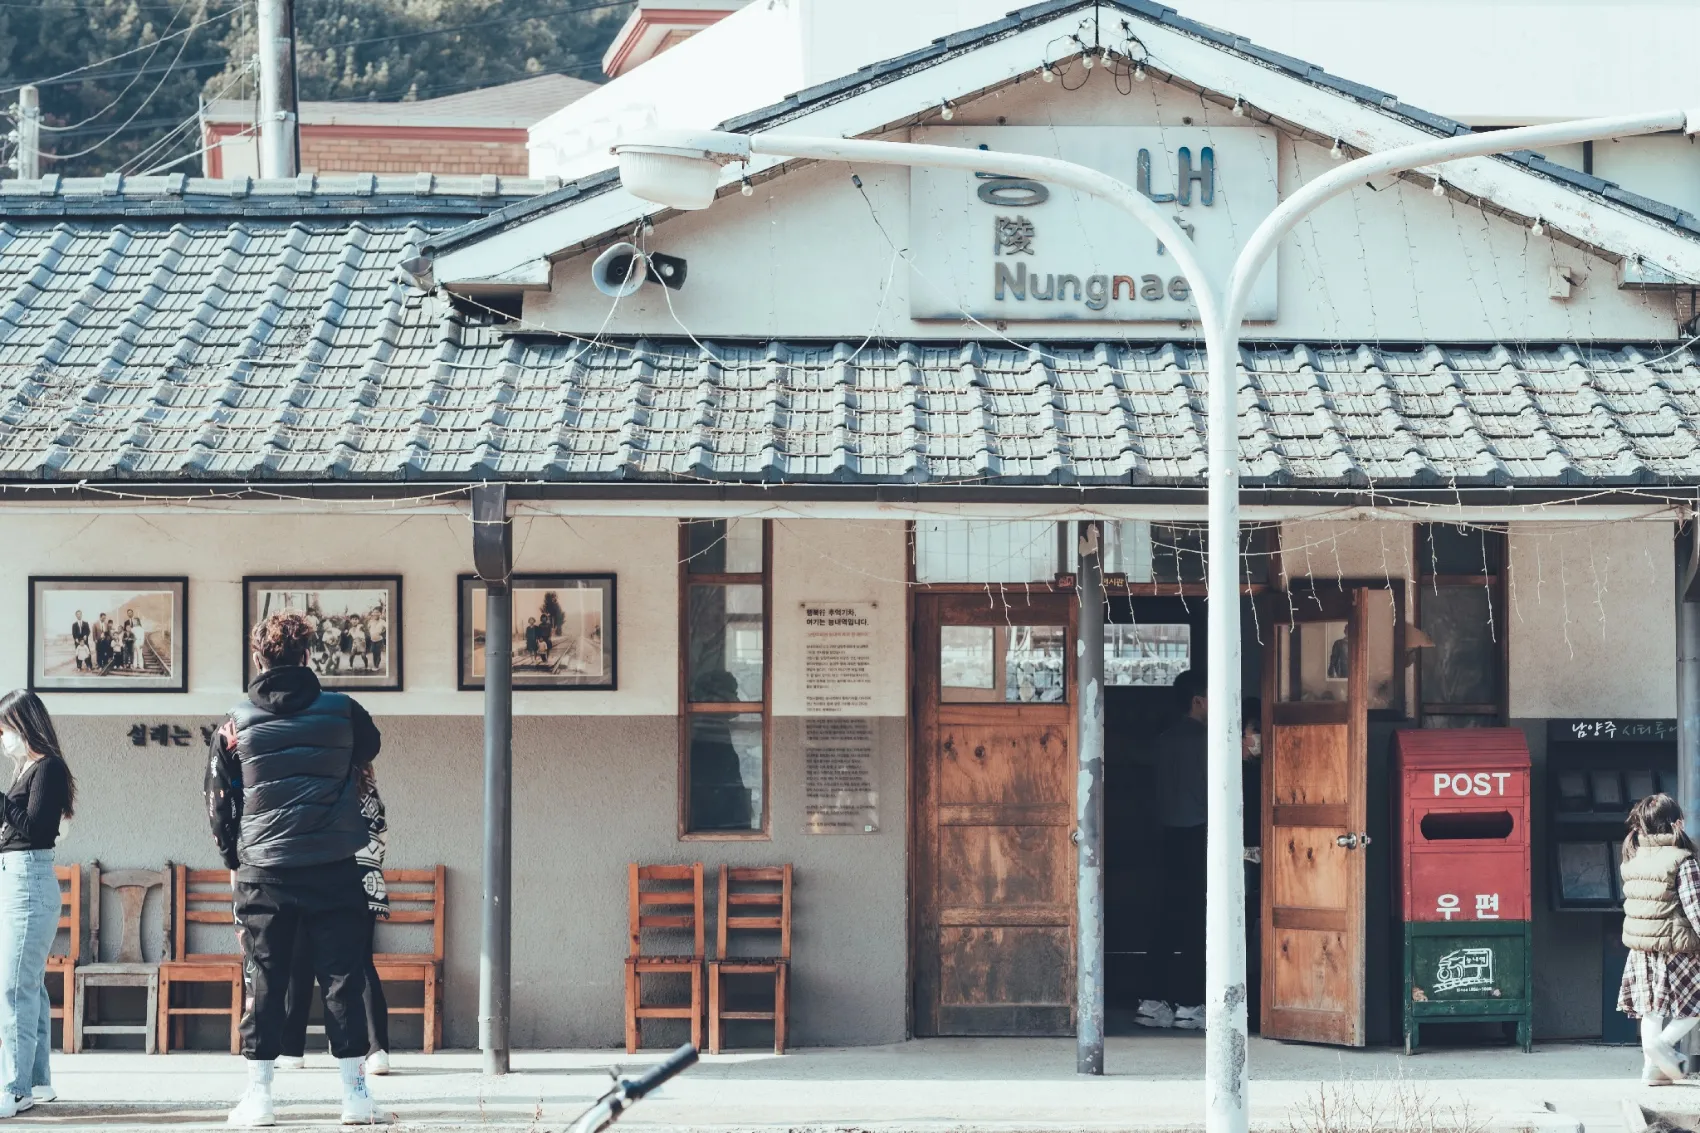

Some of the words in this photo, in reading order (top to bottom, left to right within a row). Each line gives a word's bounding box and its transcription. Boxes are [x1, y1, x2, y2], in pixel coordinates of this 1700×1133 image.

[994, 215, 1035, 256] 陵
[994, 262, 1191, 311] Nungnae
[126, 723, 193, 747] 설레는
[1571, 720, 1617, 739] 남양주
[1433, 772, 1511, 797] POST
